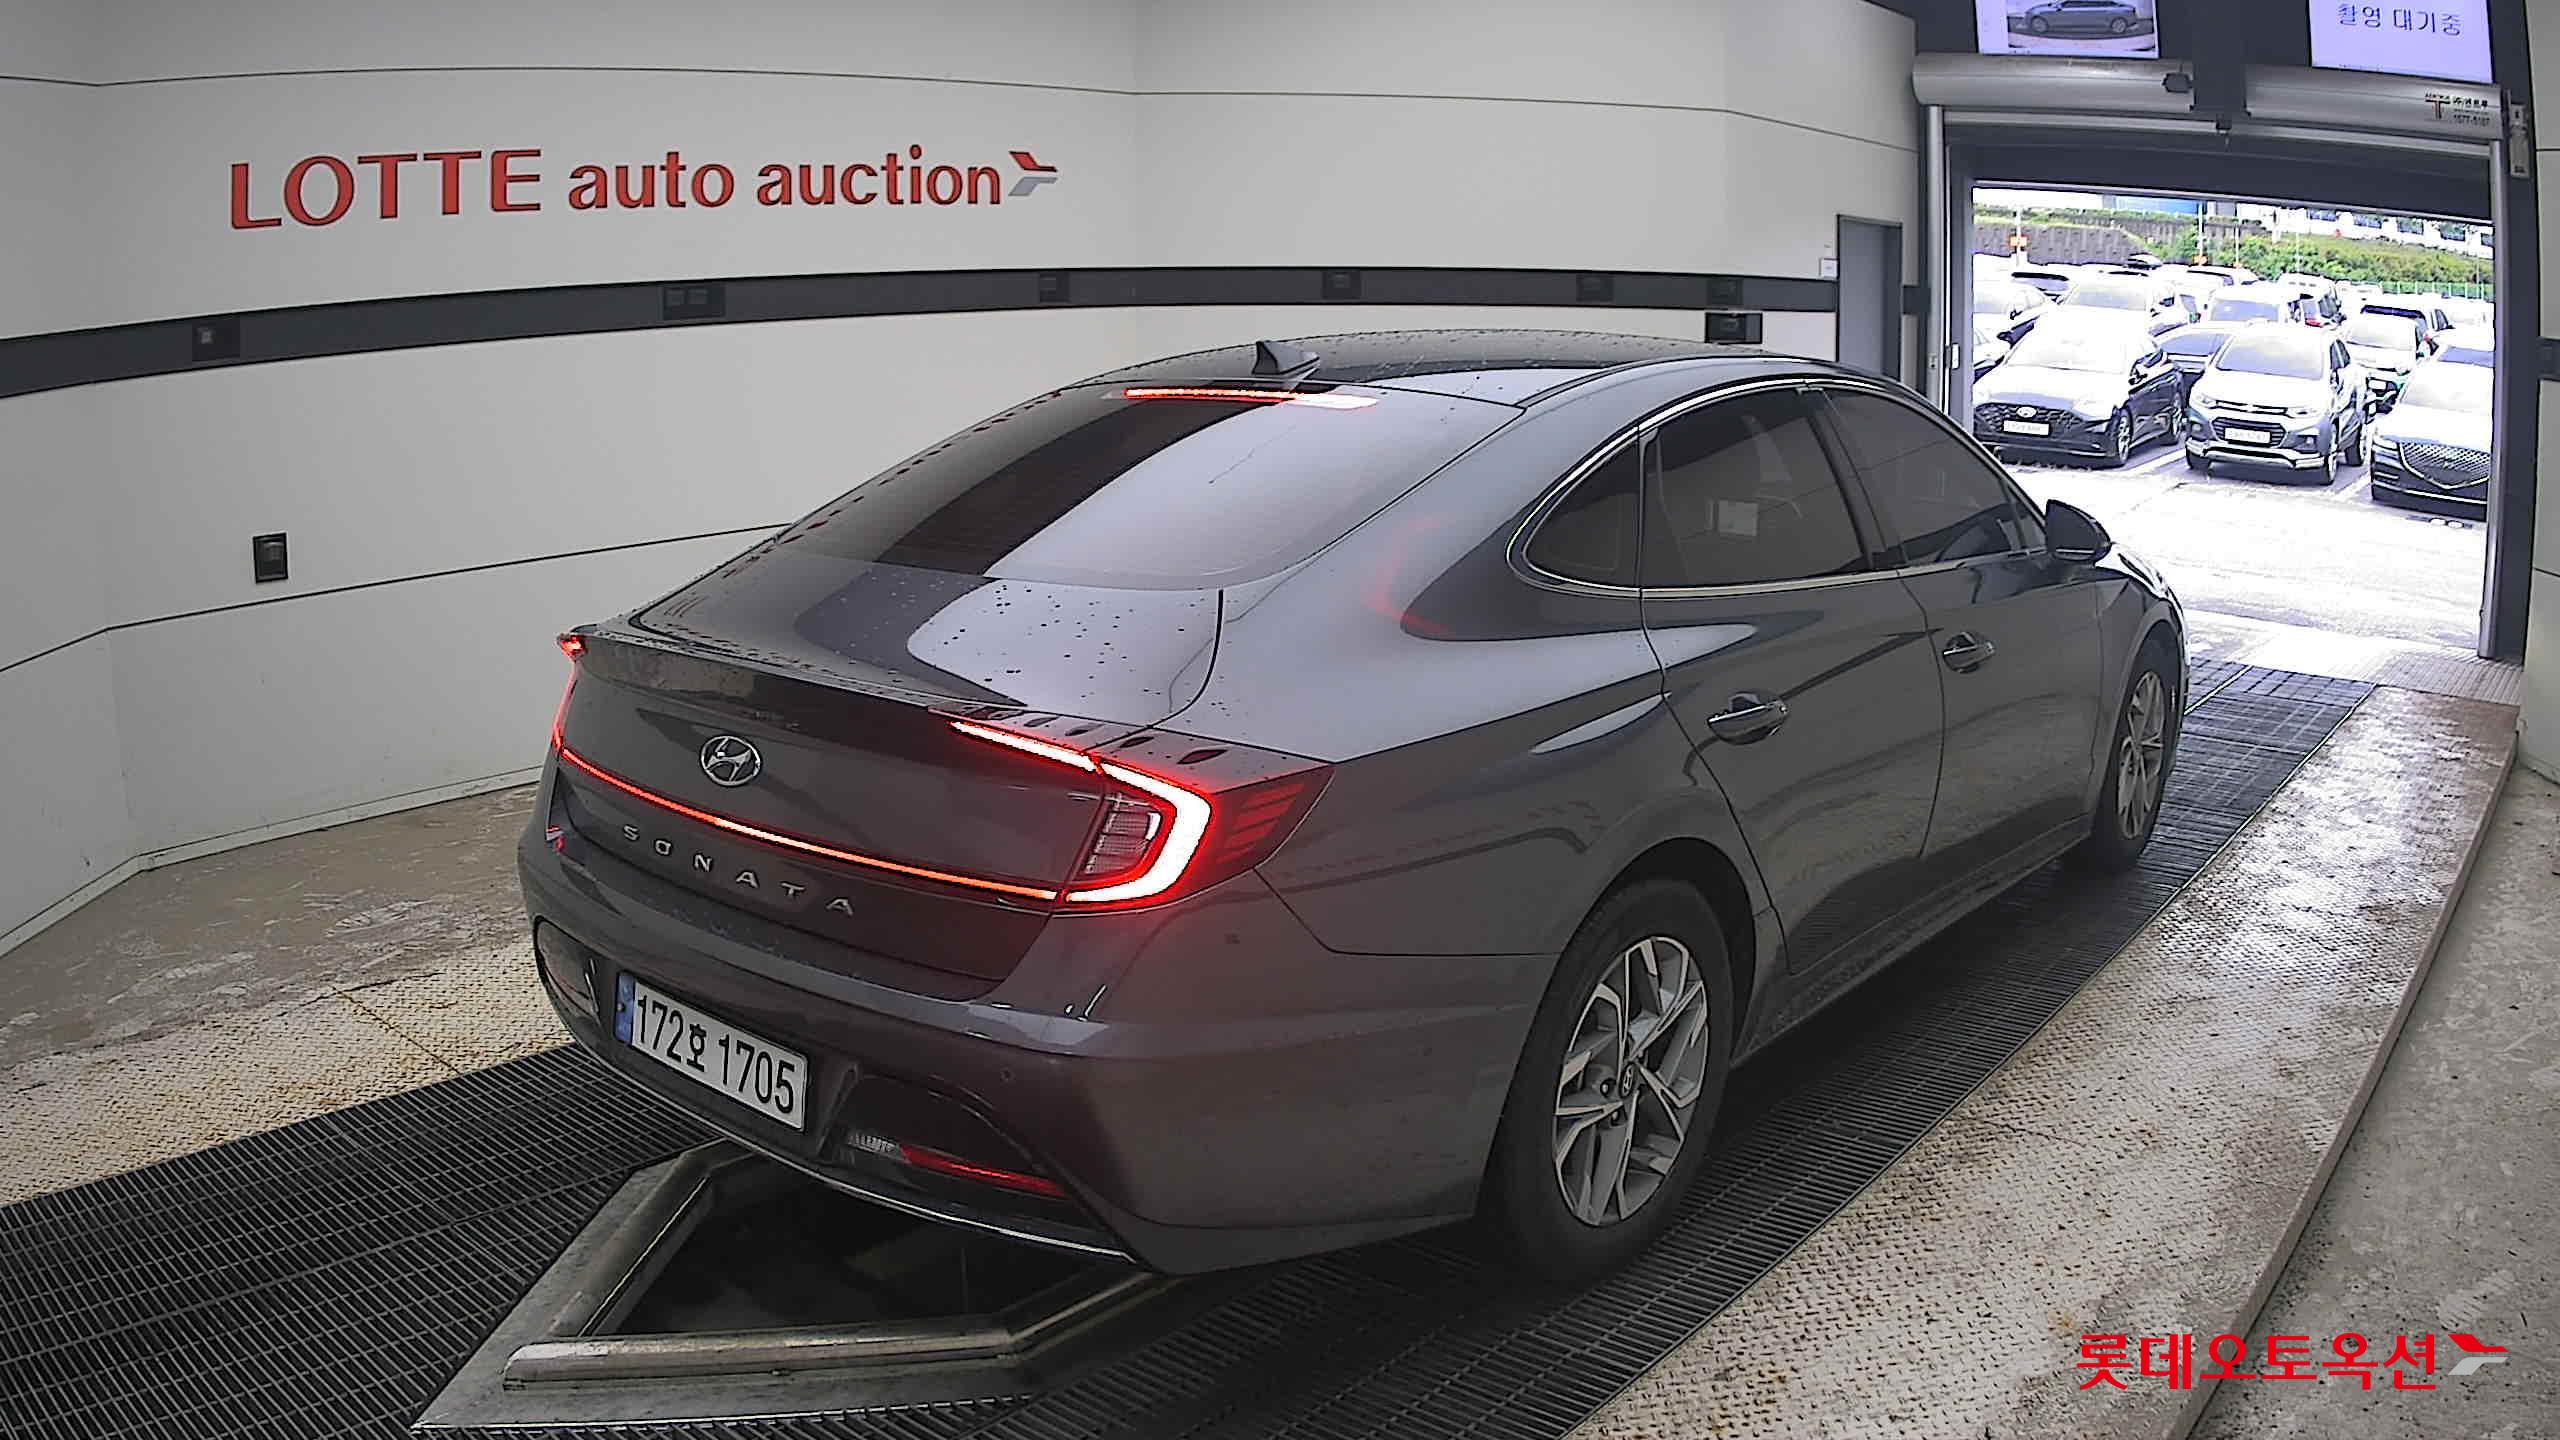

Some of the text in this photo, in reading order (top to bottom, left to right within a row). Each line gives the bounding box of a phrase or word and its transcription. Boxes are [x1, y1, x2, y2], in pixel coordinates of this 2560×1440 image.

[2338, 4, 2461, 37] 촬영 대기중
[230, 146, 1002, 230] LOTTE auto auction
[623, 824, 854, 916] SONATA
[637, 994, 796, 1114] 172호 1705
